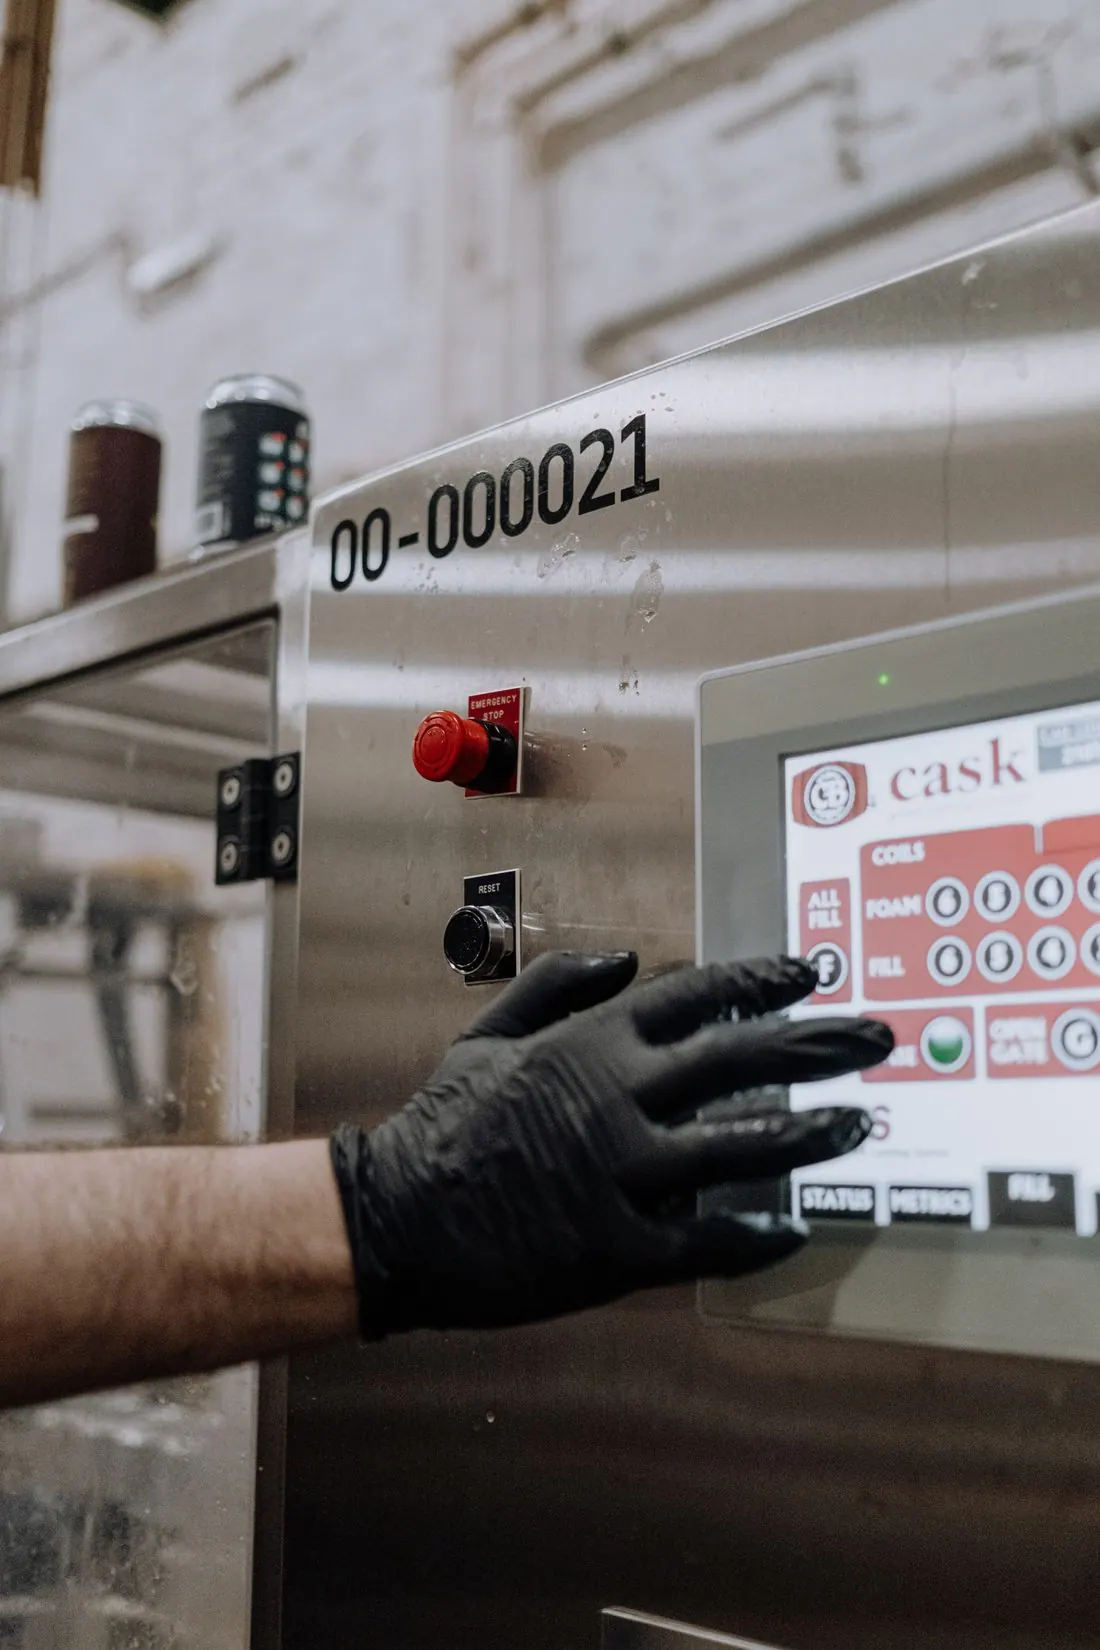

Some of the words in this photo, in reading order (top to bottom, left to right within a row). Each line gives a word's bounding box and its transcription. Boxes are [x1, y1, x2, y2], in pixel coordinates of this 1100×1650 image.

[330, 413, 660, 592] 00-000021
[471, 694, 517, 710] EMERGENCY
[483, 710, 504, 722] STOP
[890, 736, 1027, 802] cask
[478, 882, 501, 894] RESET
[807, 888, 841, 911] ALL
[808, 908, 843, 930] FILL
[802, 1187, 874, 1212] STATUS
